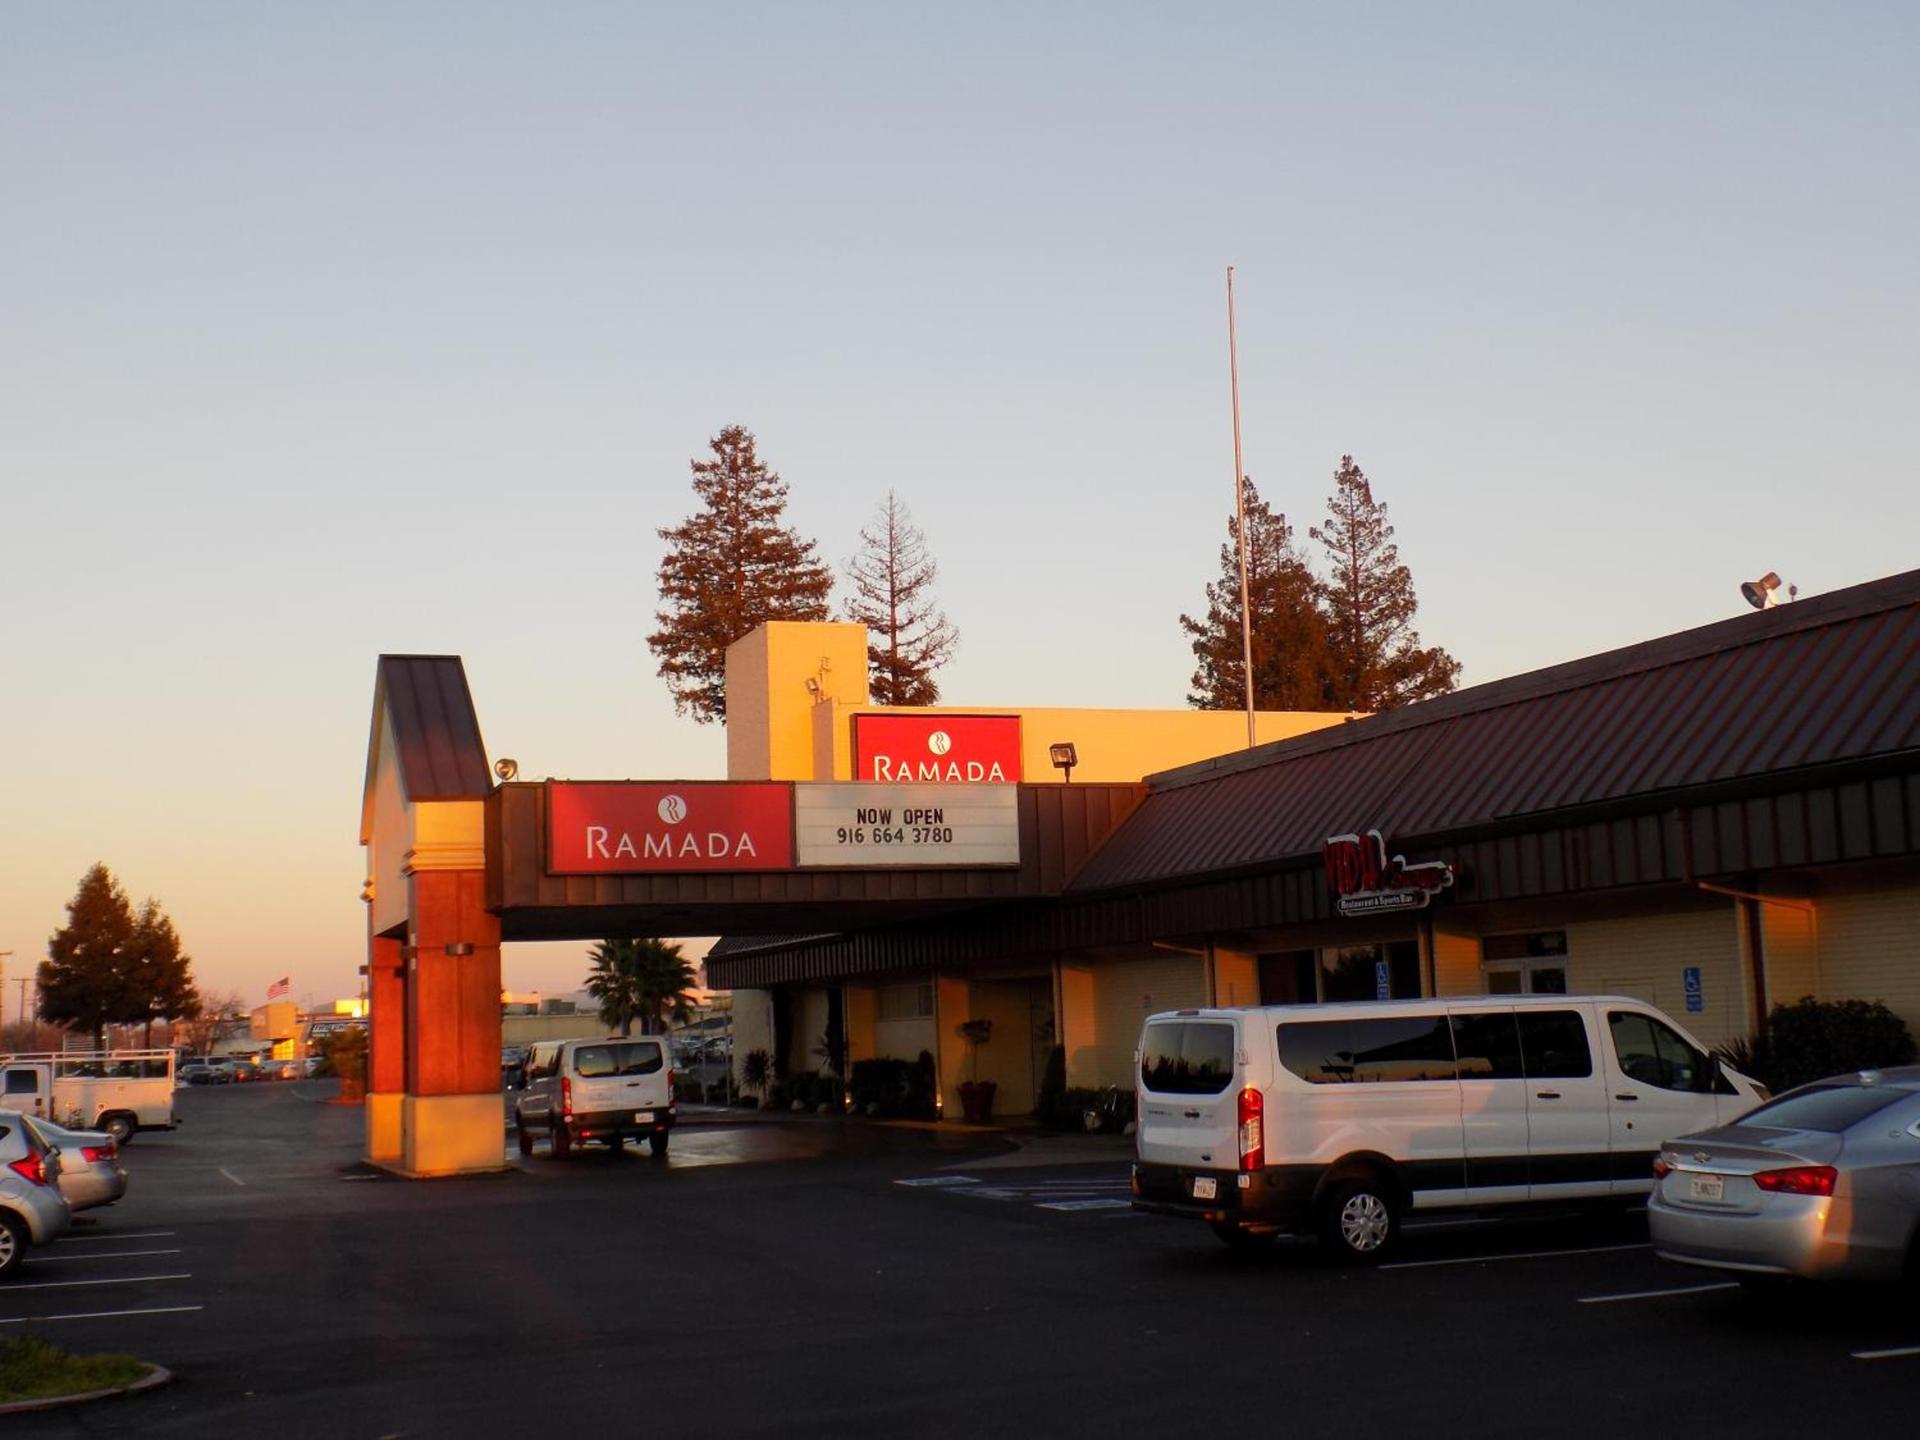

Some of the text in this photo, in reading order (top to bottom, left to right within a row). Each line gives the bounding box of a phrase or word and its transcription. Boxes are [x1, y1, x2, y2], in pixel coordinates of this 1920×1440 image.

[874, 755, 1005, 782] RAMADA
[857, 808, 944, 824] NOW OPEN
[586, 826, 757, 859] RAMADA
[837, 827, 952, 845] 916 664 3780
